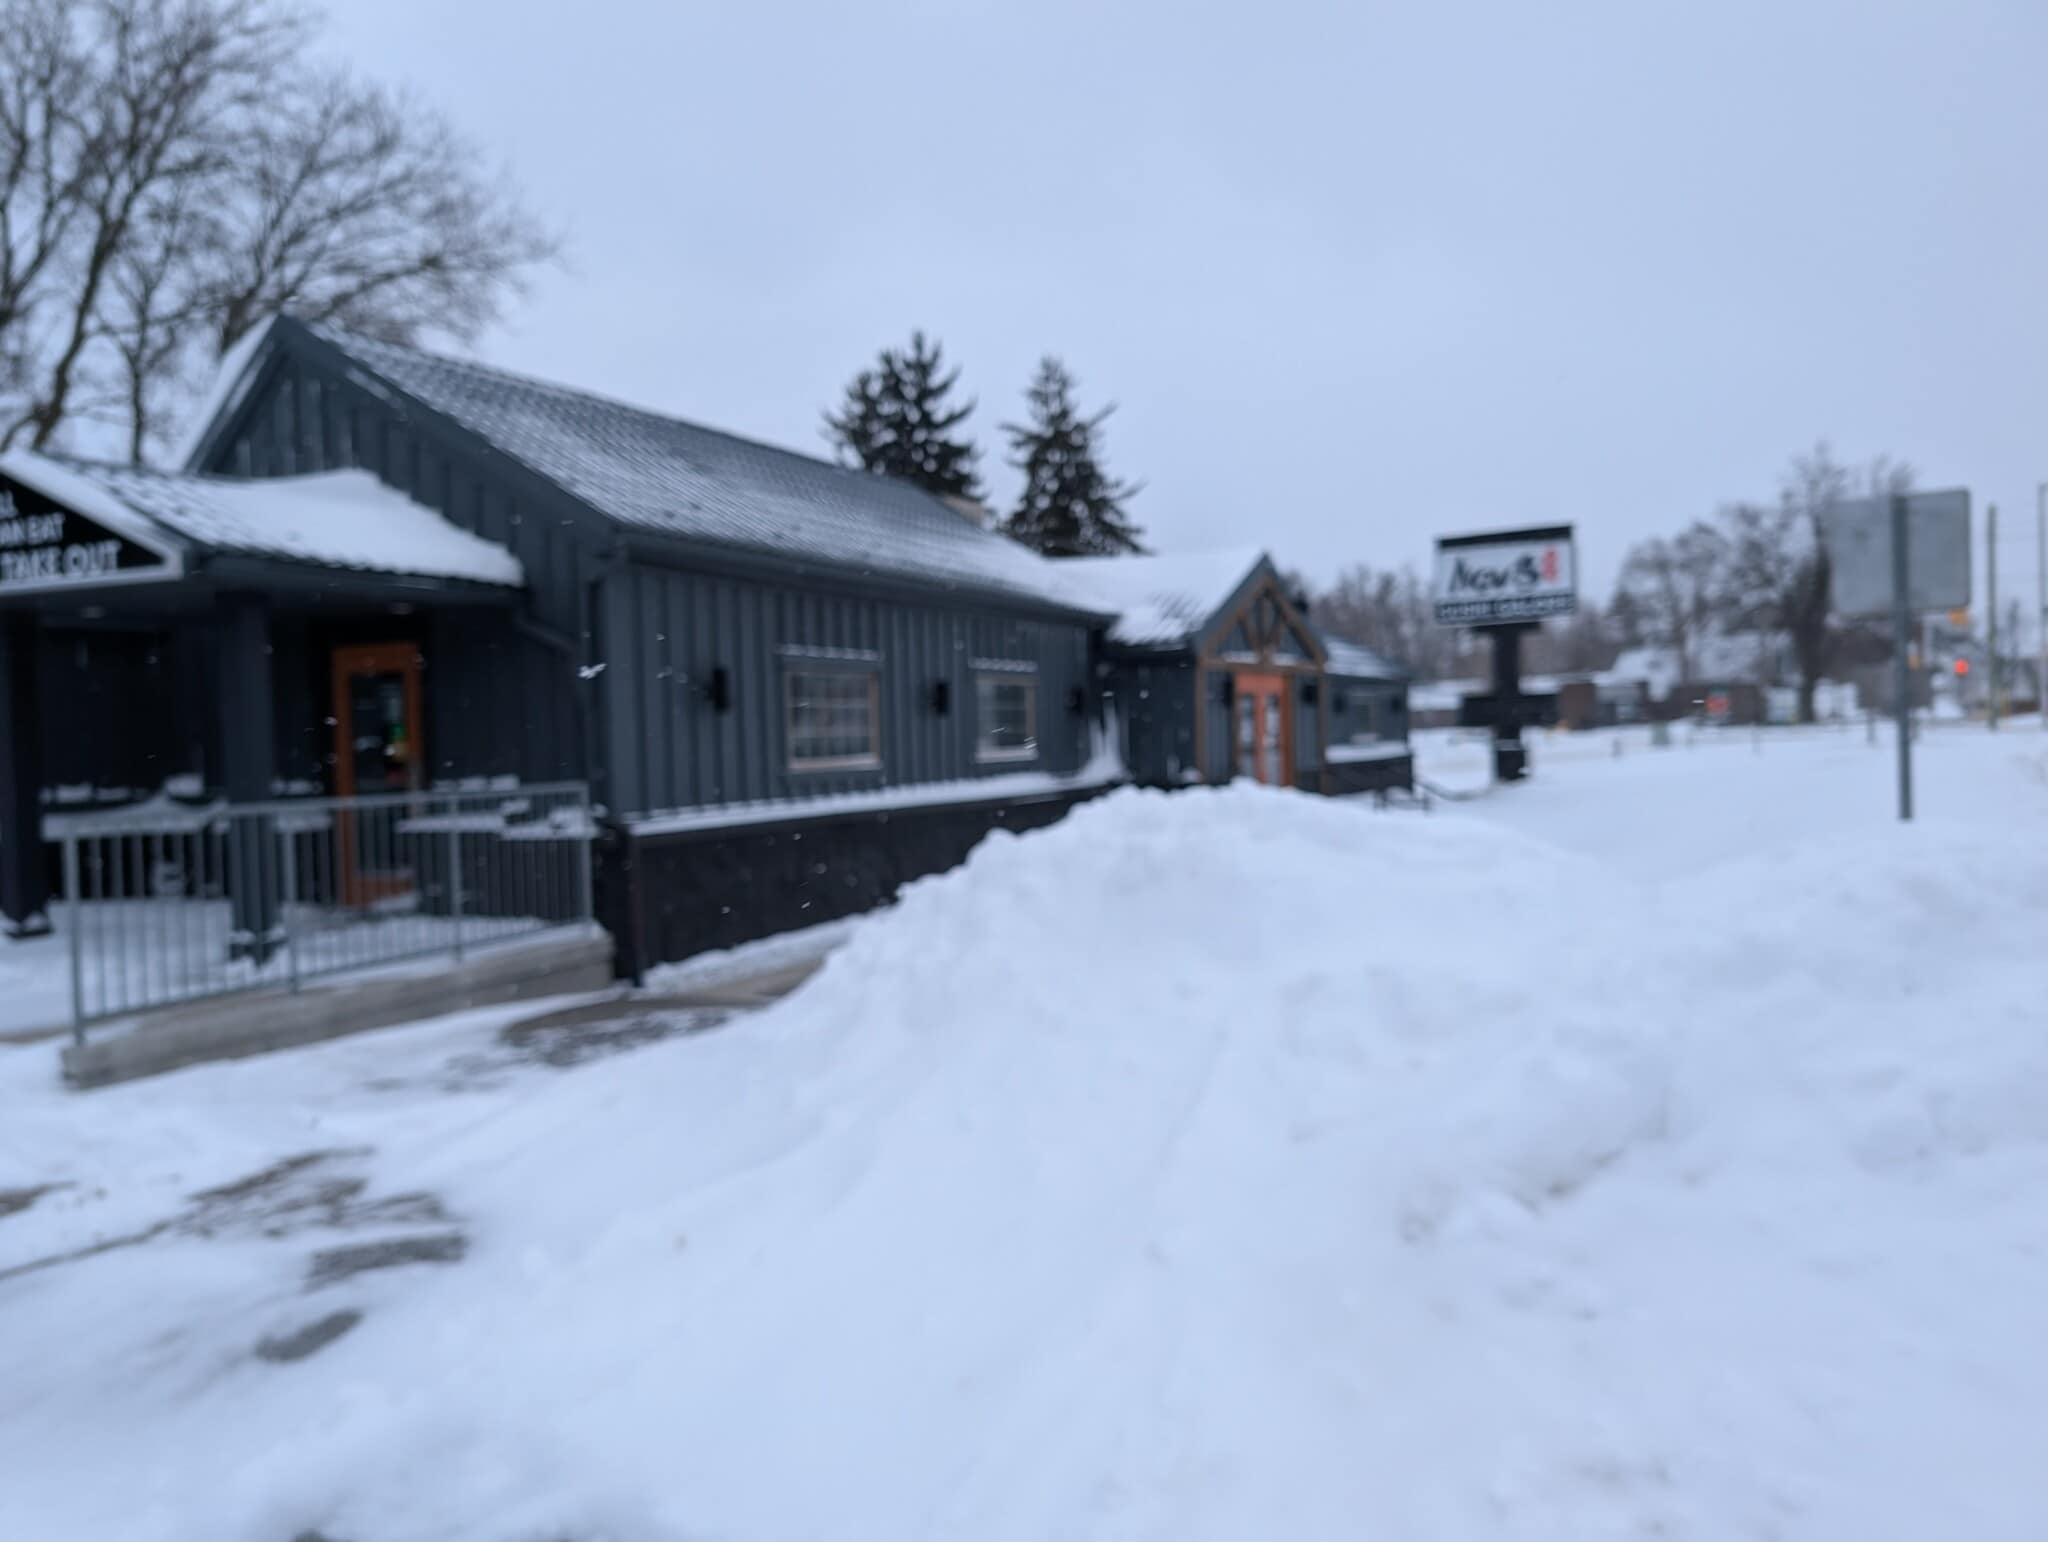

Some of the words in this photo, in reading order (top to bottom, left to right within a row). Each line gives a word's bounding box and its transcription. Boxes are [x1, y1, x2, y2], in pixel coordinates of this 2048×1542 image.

[26, 513, 64, 543] EAT
[1, 546, 60, 580] TAKE
[63, 541, 121, 576] OUT
